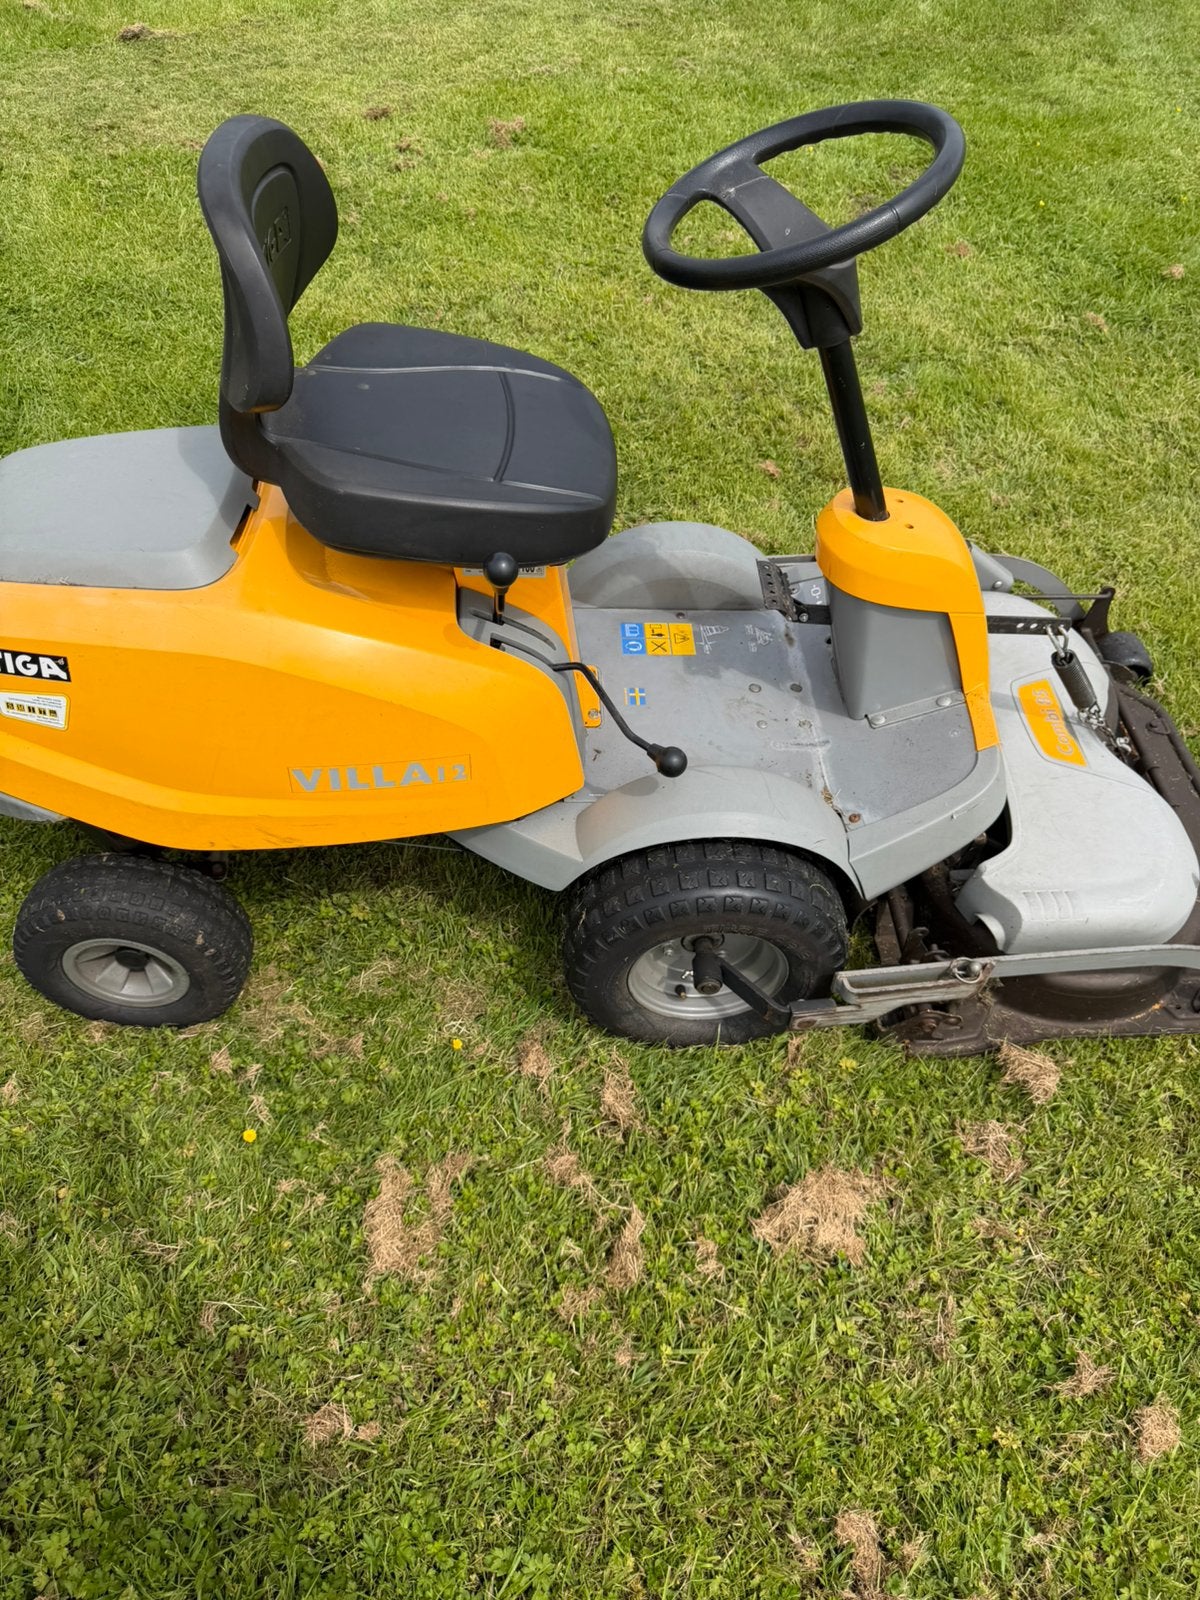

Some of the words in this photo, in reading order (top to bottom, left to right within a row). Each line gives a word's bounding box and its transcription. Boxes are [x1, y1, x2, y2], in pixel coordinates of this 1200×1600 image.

[0, 651, 68, 680] IGA
[1041, 709, 1073, 755] Combi
[291, 761, 433, 792] VILLA
